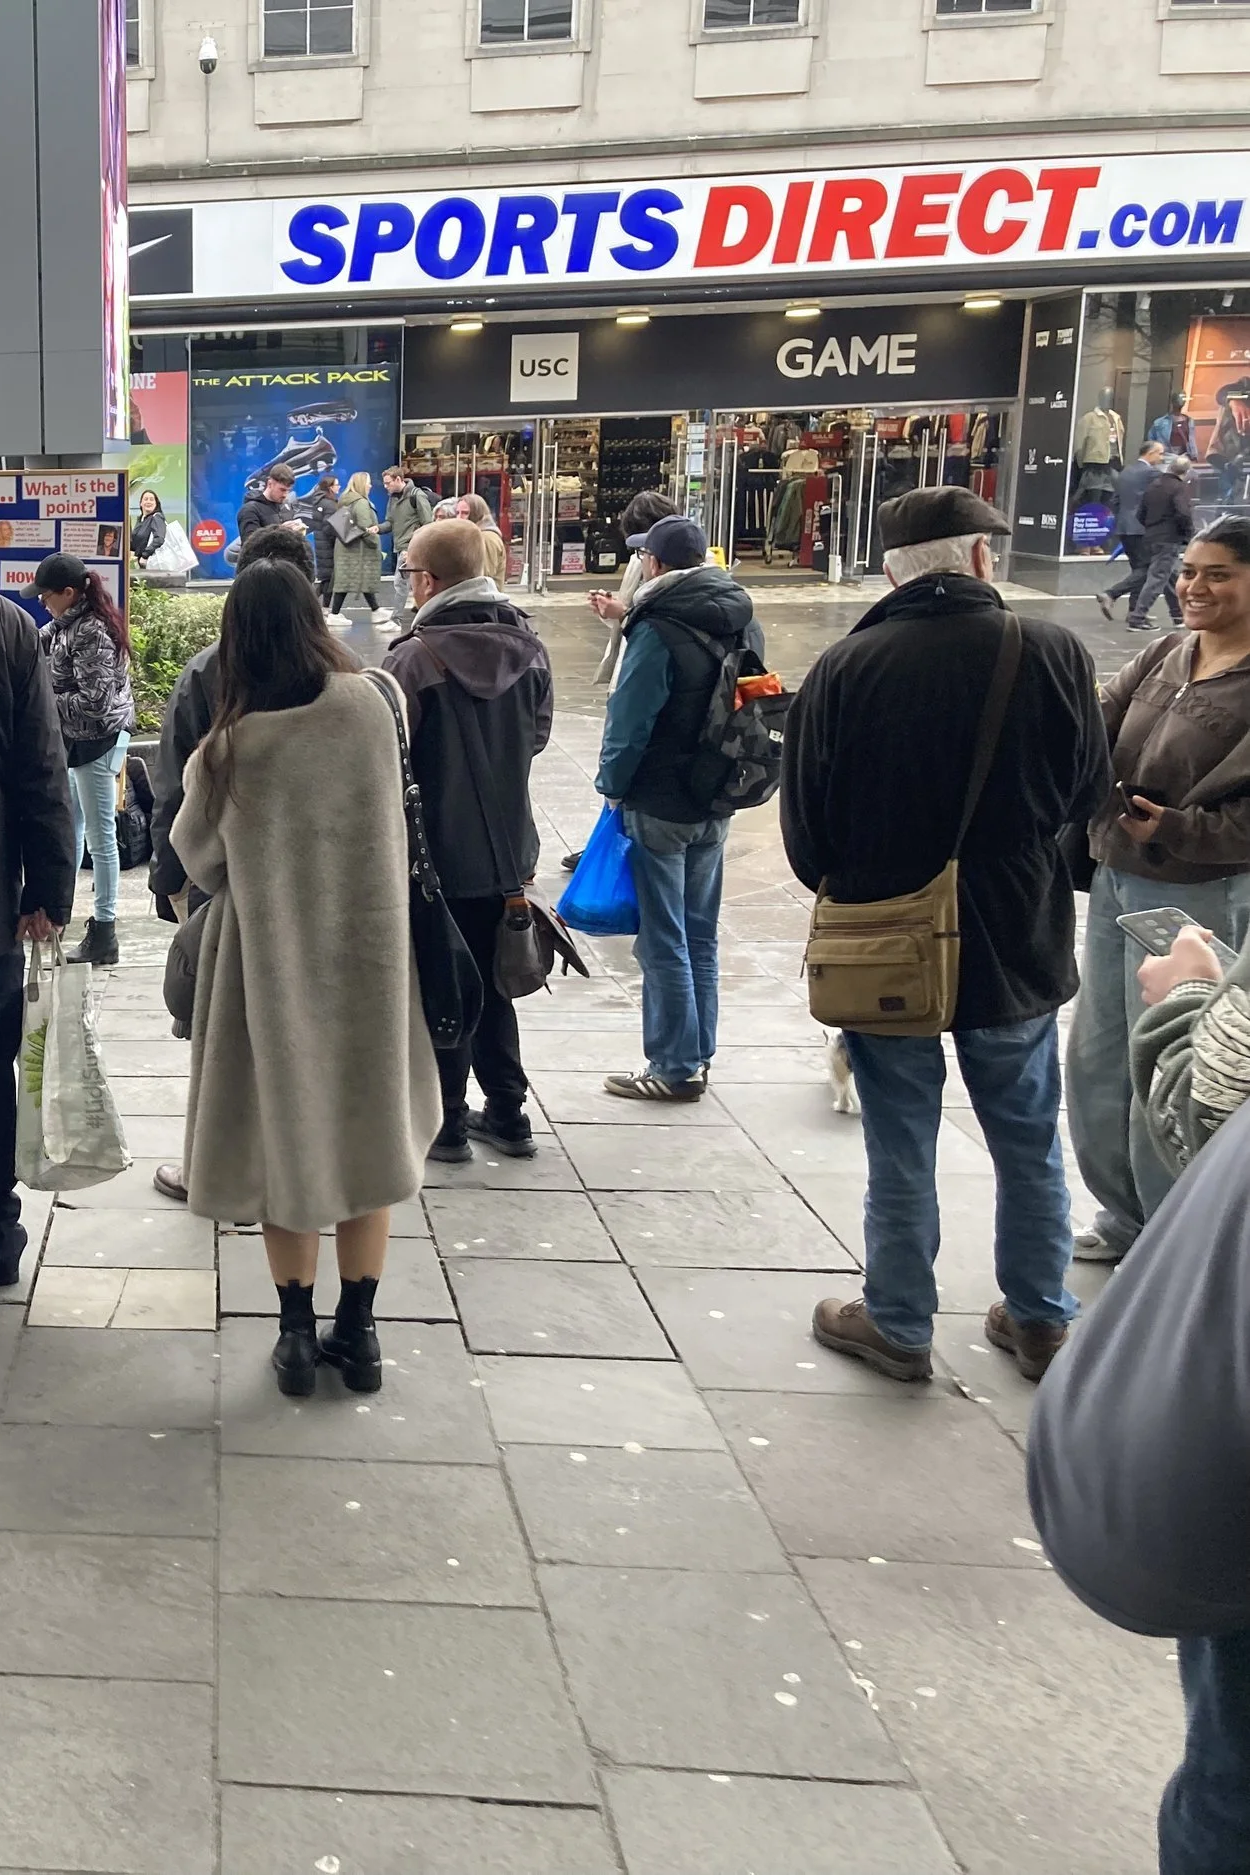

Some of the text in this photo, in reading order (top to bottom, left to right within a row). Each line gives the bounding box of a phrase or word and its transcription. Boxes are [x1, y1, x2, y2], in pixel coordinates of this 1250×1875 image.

[279, 188, 684, 285] SPORTS
[692, 166, 1102, 268] DIRECT
[775, 333, 918, 379] GAME
[518, 357, 569, 379] USC
[192, 370, 390, 387] THE ATTACK PACK
[25, 477, 116, 496] What is the
[46, 499, 95, 517] point?
[196, 529, 223, 537] SALE
